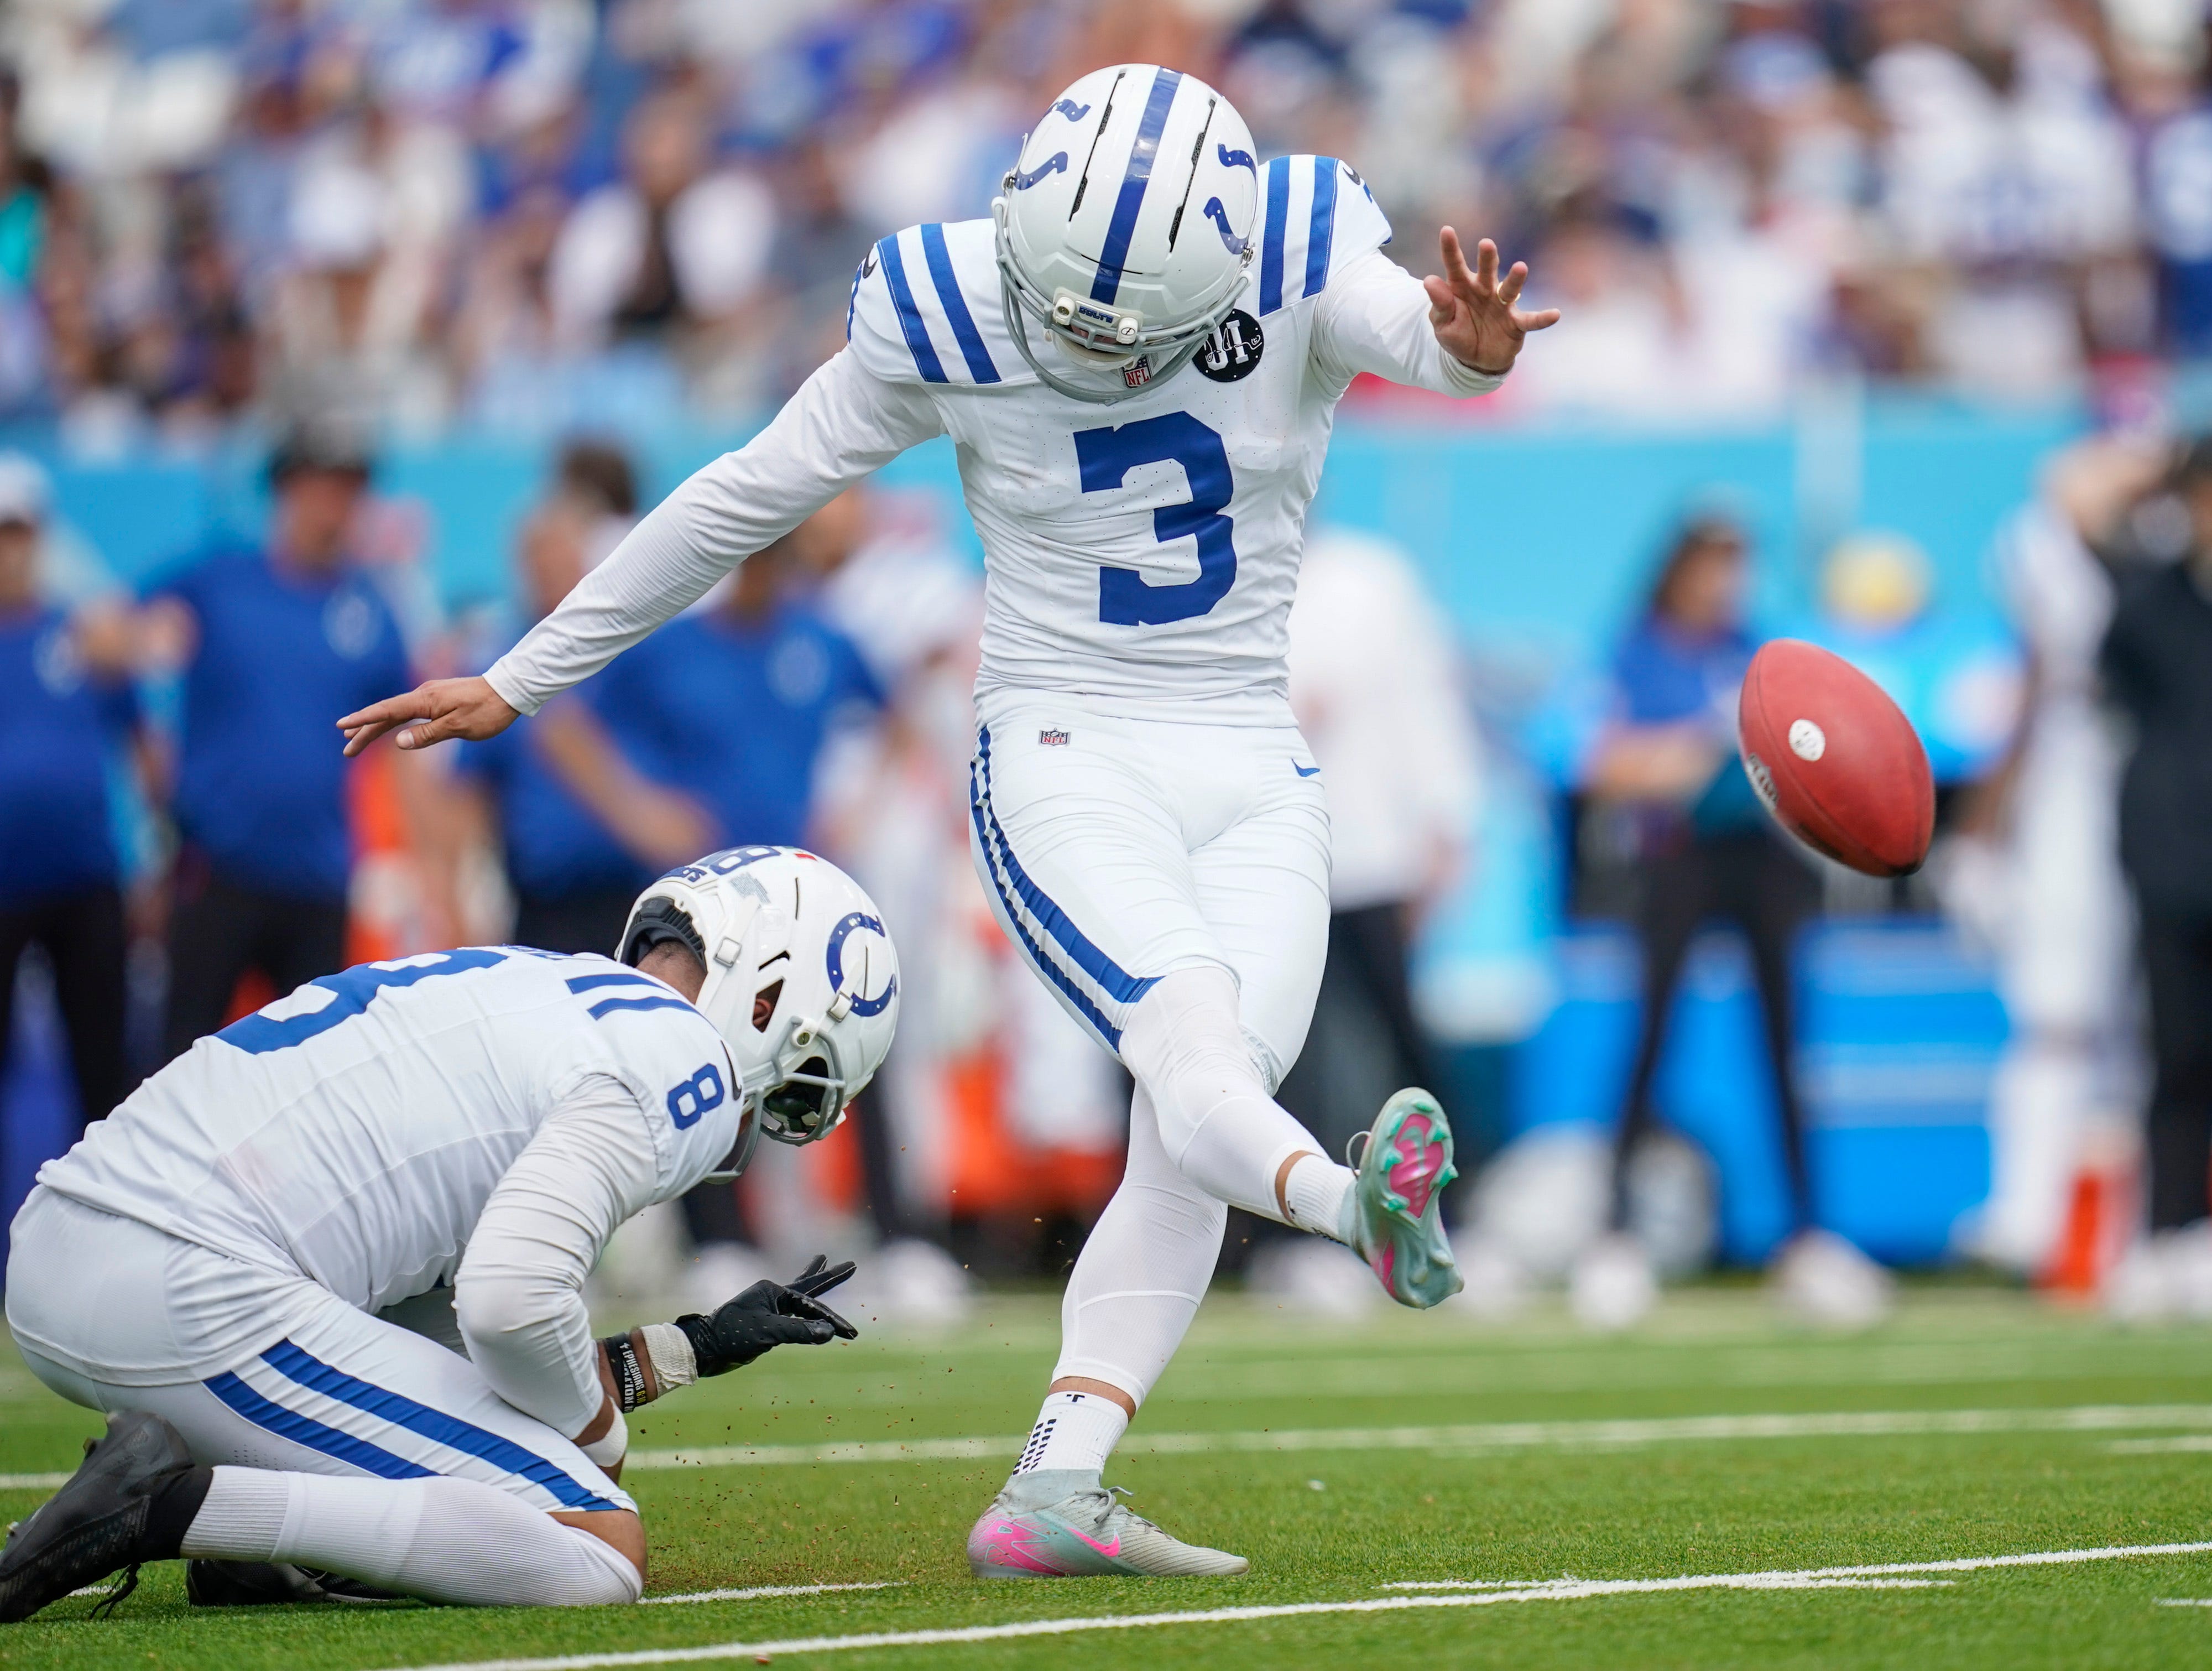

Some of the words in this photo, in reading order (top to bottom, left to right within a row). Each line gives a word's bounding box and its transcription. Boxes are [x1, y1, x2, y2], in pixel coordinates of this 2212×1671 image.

[1078, 305, 1114, 324] COLTS
[1125, 368, 1150, 386] NFL
[1073, 410, 1238, 627] 3
[667, 1062, 725, 1131] 8
[622, 1350, 645, 1391] EPHESIANS
